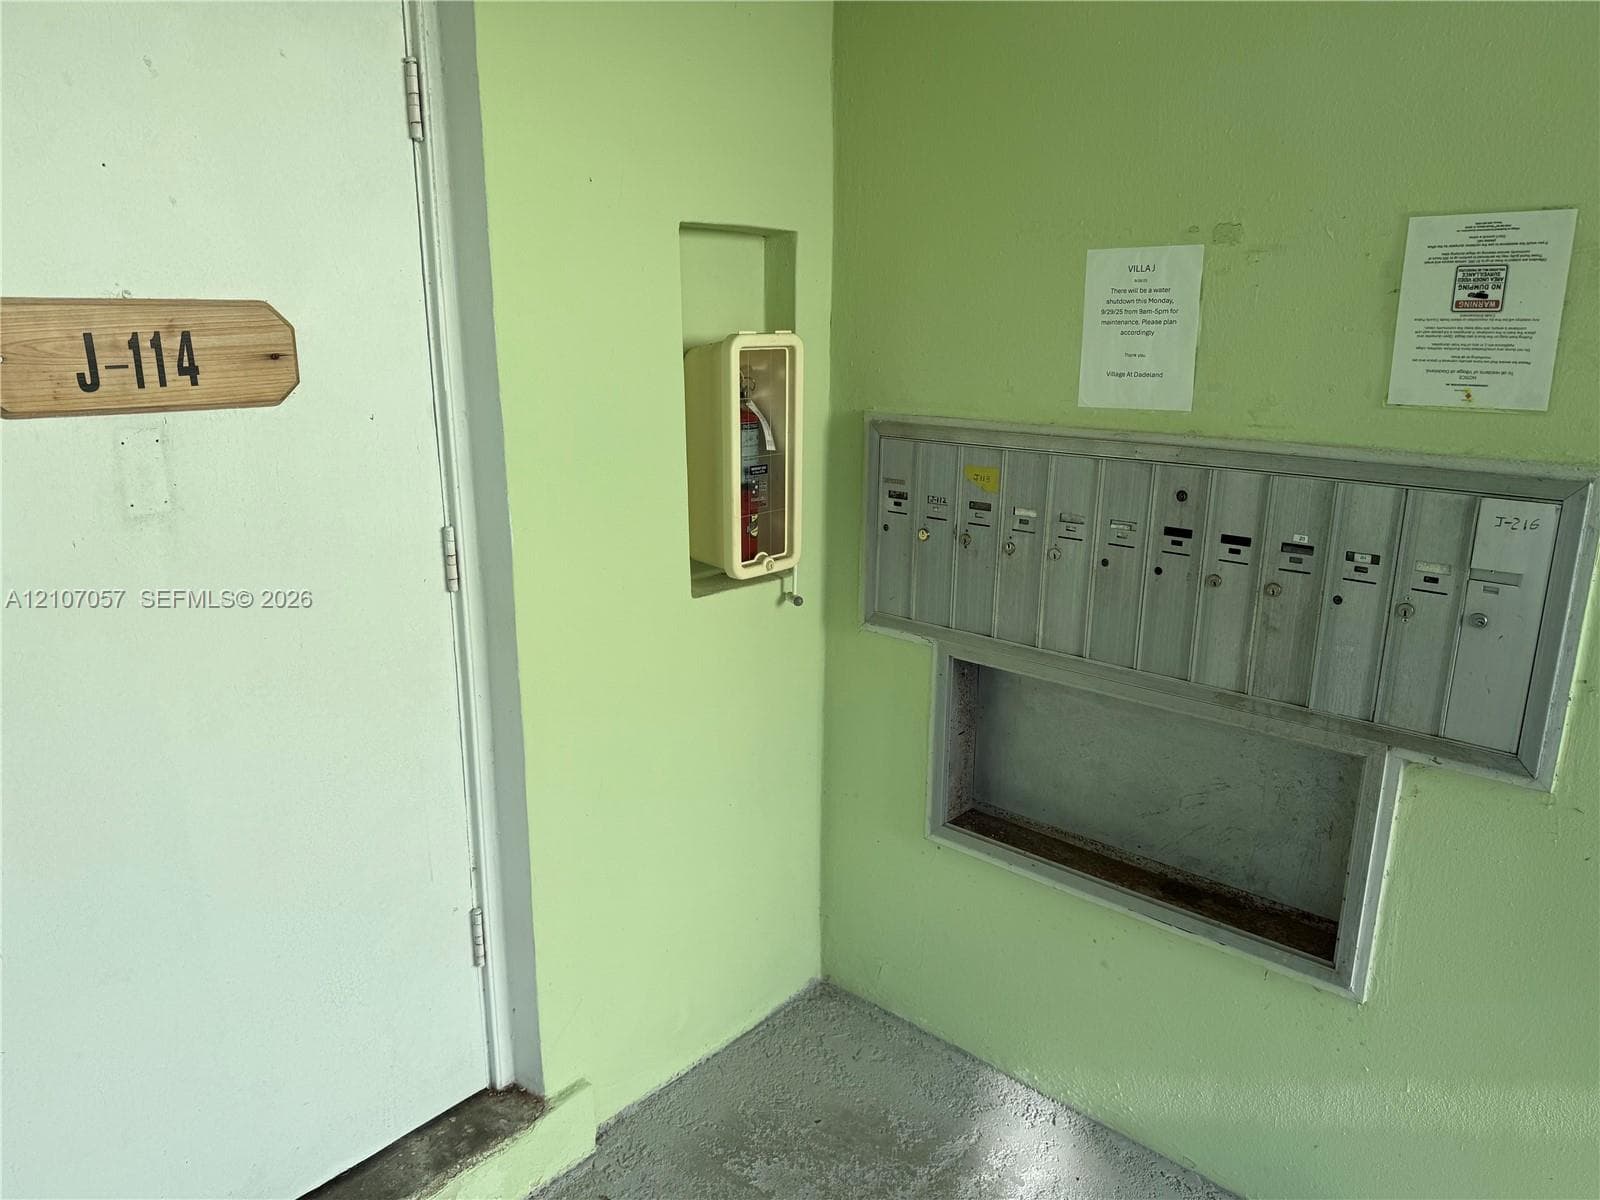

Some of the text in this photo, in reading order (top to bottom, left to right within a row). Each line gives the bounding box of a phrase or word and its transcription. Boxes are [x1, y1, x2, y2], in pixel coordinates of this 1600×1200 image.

[1128, 264, 1157, 273] VILLA J
[1148, 297, 1175, 305] Monday,
[1458, 300, 1496, 308] WARNING
[1163, 318, 1178, 326] plan
[76, 330, 200, 393] J-114
[1494, 516, 1541, 531] J-216
